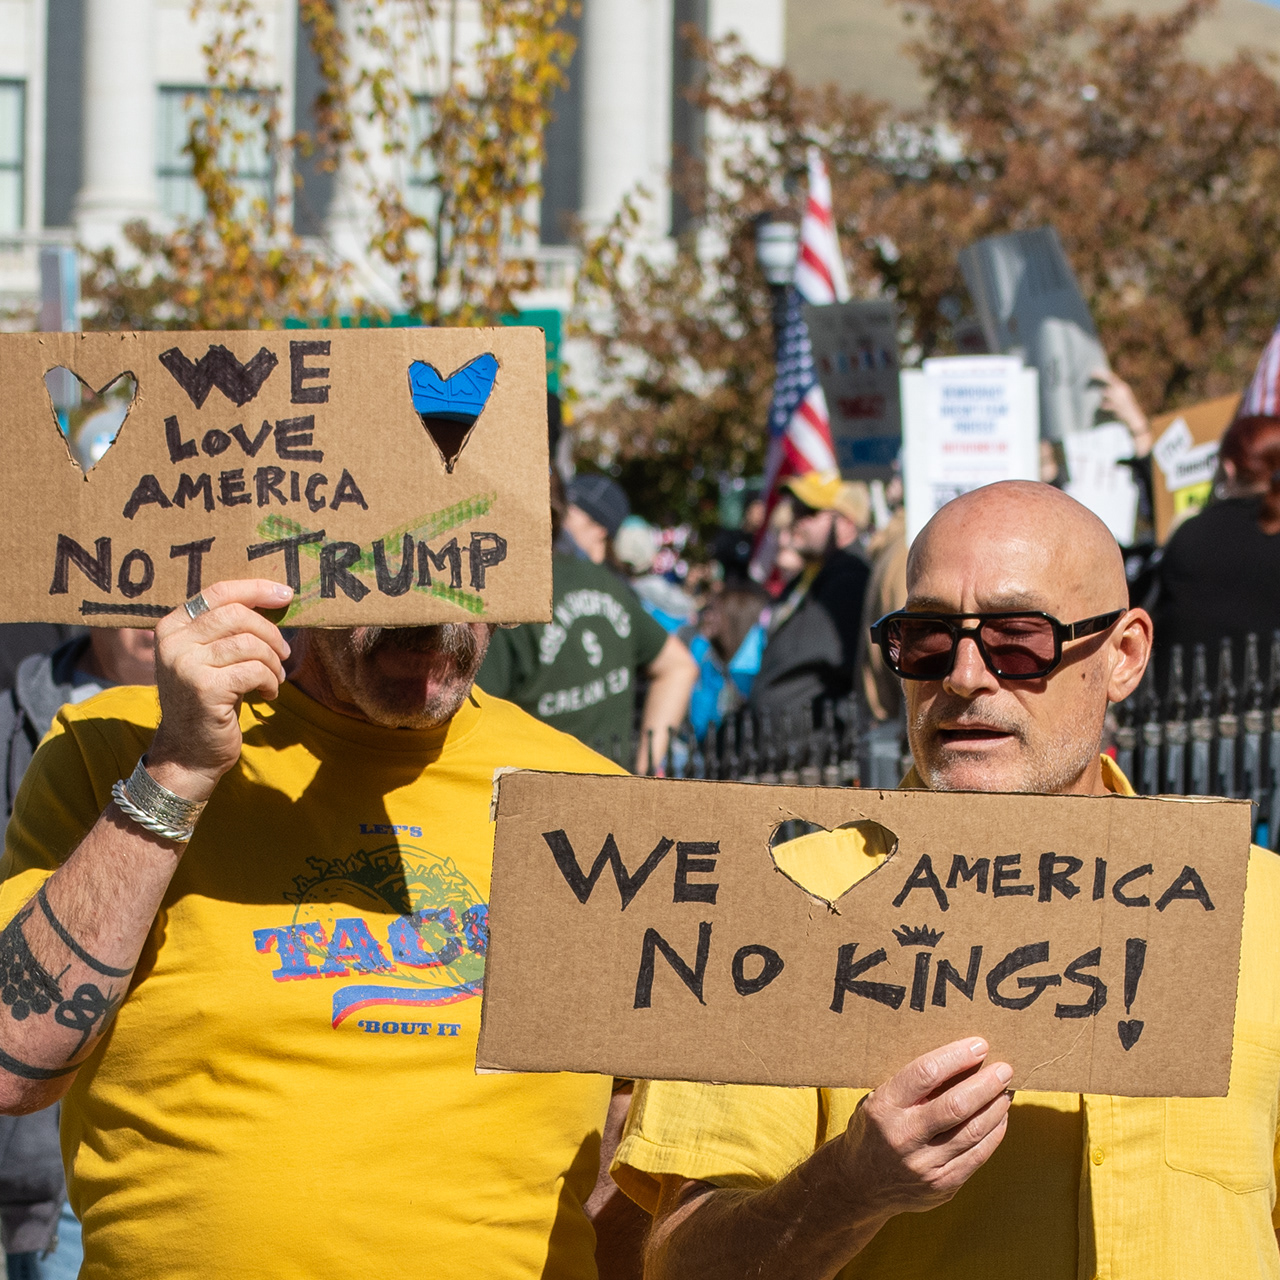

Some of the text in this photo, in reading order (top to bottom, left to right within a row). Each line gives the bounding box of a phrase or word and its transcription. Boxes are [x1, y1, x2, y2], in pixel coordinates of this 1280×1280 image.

[159, 340, 331, 409] WE
[163, 415, 324, 464] LOVE
[123, 466, 368, 520] AMERICA
[49, 530, 508, 602] NOT TRUMP
[359, 823, 424, 838] LET'S
[542, 829, 1216, 911] WE AMERICA
[632, 921, 784, 1009] NO
[358, 1019, 462, 1037] 'BOUT IT
